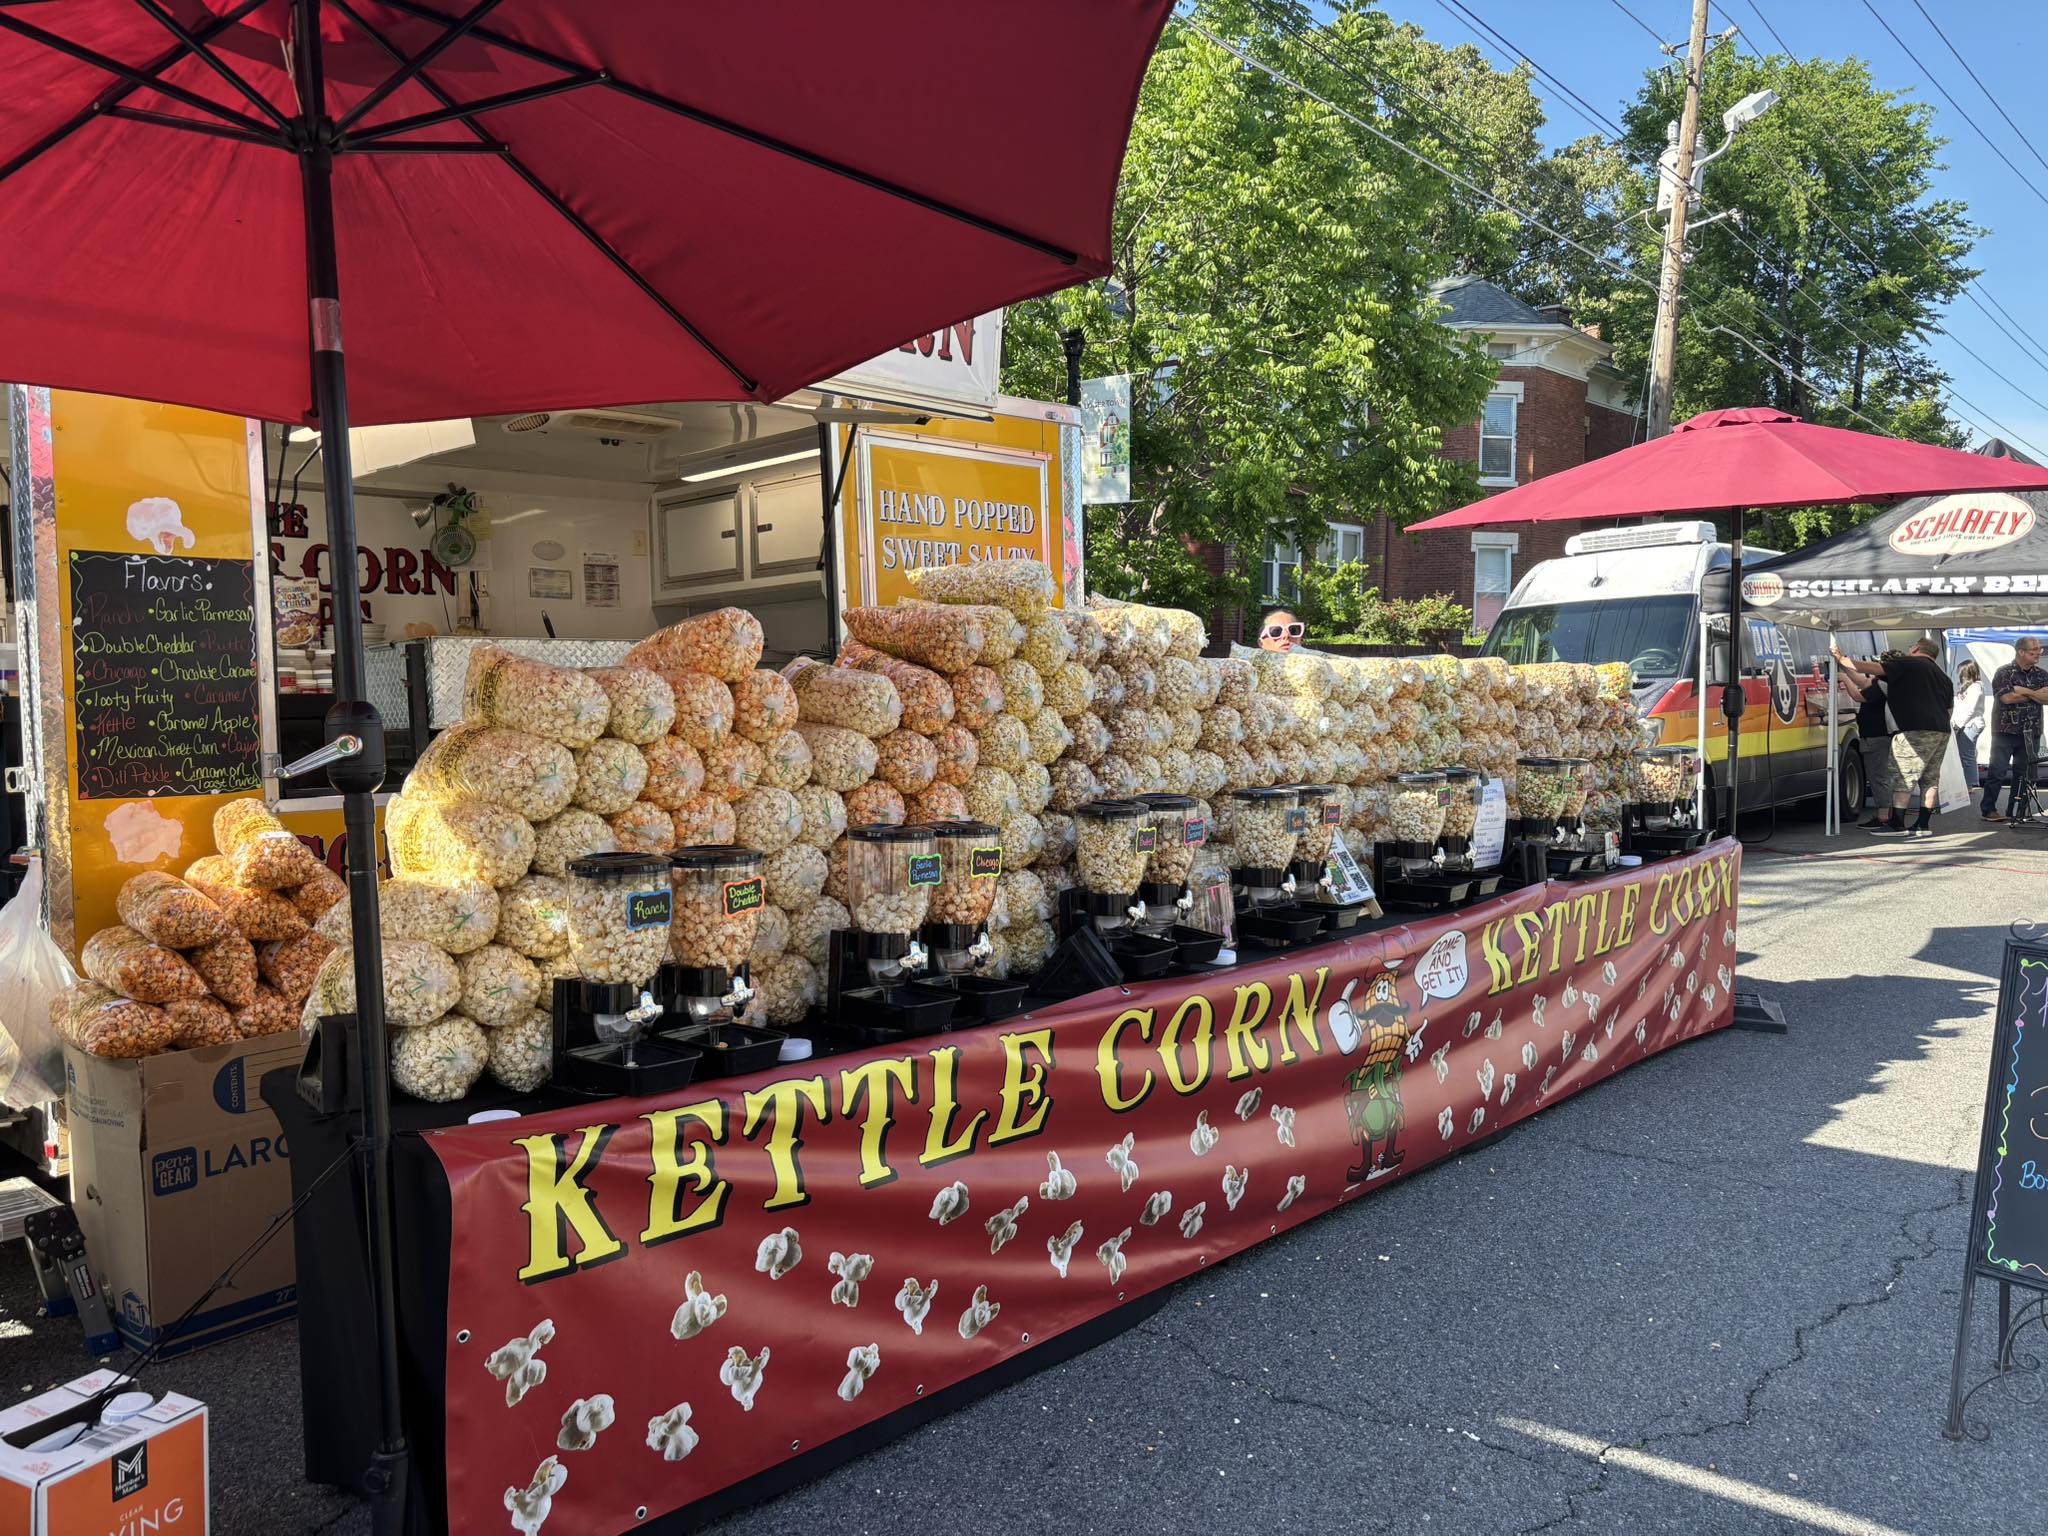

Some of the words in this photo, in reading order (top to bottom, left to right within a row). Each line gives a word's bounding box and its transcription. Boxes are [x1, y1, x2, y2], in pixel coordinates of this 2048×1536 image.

[880, 489, 946, 526] HAND
[954, 498, 1036, 534] POPPED
[1897, 508, 2028, 543] SCHLAFLY
[882, 537, 963, 570] SWEET
[125, 560, 213, 592] Flavors:
[1789, 576, 1978, 598] SCHLAFLY
[155, 597, 198, 622] Garlic
[85, 632, 145, 653] Double
[146, 631, 197, 654] Cheddar
[93, 659, 147, 686] Chicago
[134, 683, 174, 715] Fruity
[194, 683, 248, 704] Caramel
[94, 708, 136, 737] Kettle
[156, 711, 209, 732] Caramel
[211, 706, 252, 734] Apple
[97, 735, 158, 766] Mexican
[194, 734, 221, 756] Corn
[91, 766, 128, 788] Dill
[181, 757, 250, 782] Cinnamon
[976, 856, 999, 871] Chicago
[729, 884, 756, 899] Double
[732, 894, 762, 909] Cheddar
[634, 900, 668, 920] Ranch
[1482, 882, 1642, 996] KETTLE
[1650, 855, 1736, 935] CORN
[1431, 934, 1462, 956] COME
[1429, 951, 1451, 971] AND
[1422, 970, 1442, 991] GET
[1446, 963, 1465, 984] IT!
[512, 1028, 1057, 1284] KETTLE
[1095, 967, 1332, 1113] CORN
[160, 1165, 191, 1188] GEAR
[115, 1473, 145, 1493] Member's
[119, 1504, 144, 1522] CLEAR
